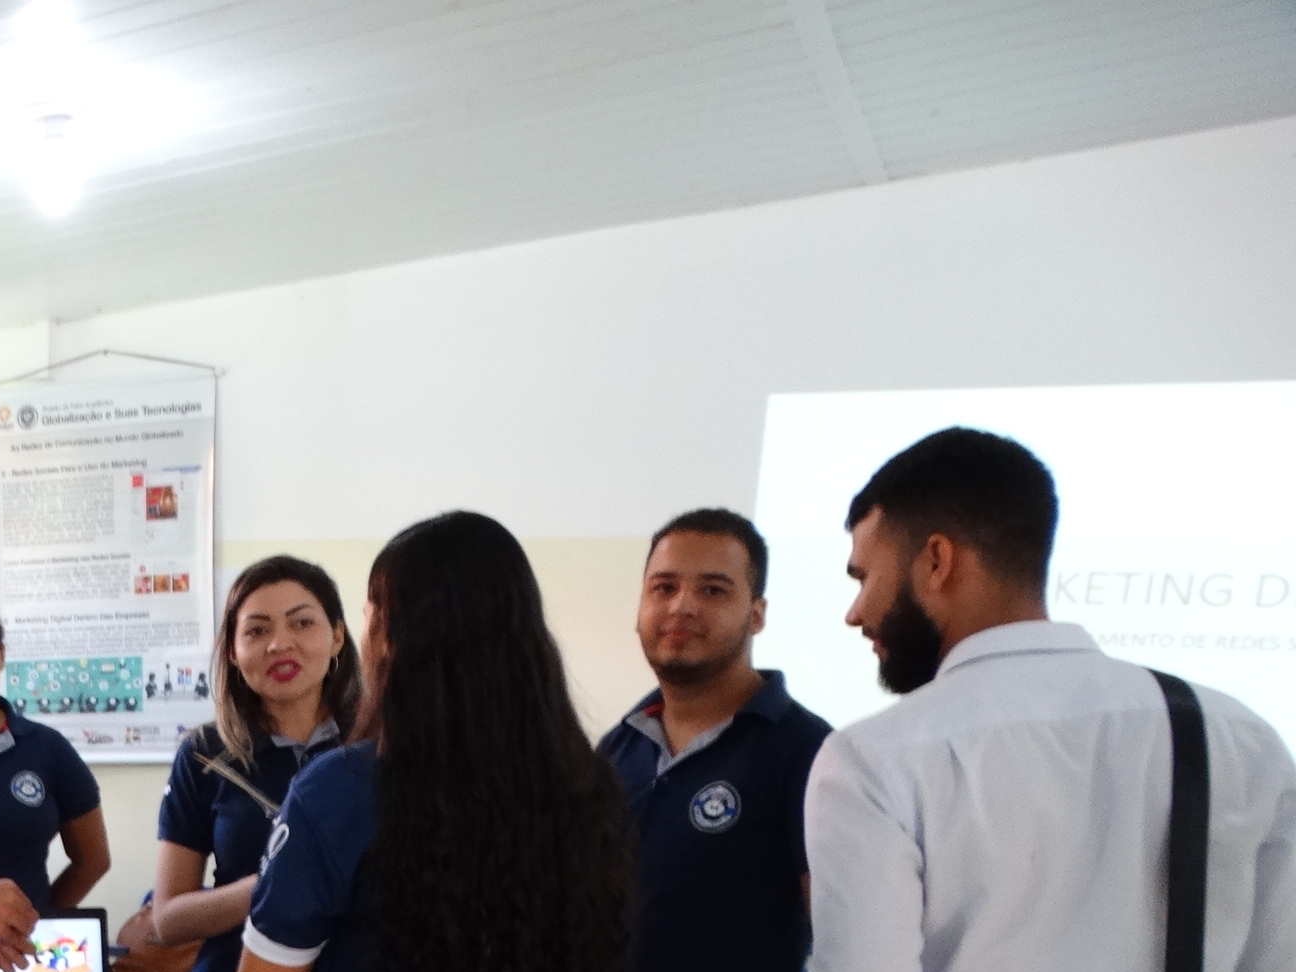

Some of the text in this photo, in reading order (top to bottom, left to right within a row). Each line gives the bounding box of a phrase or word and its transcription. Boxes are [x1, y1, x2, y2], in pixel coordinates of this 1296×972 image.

[41, 410, 103, 427] Globalização
[114, 407, 139, 419] Suas
[141, 402, 202, 417] Tecnologias
[1054, 571, 1296, 608] KETING D
[1098, 632, 1175, 648] MENTO
[1181, 633, 1206, 650] DE
[1215, 634, 1281, 652] REDES
